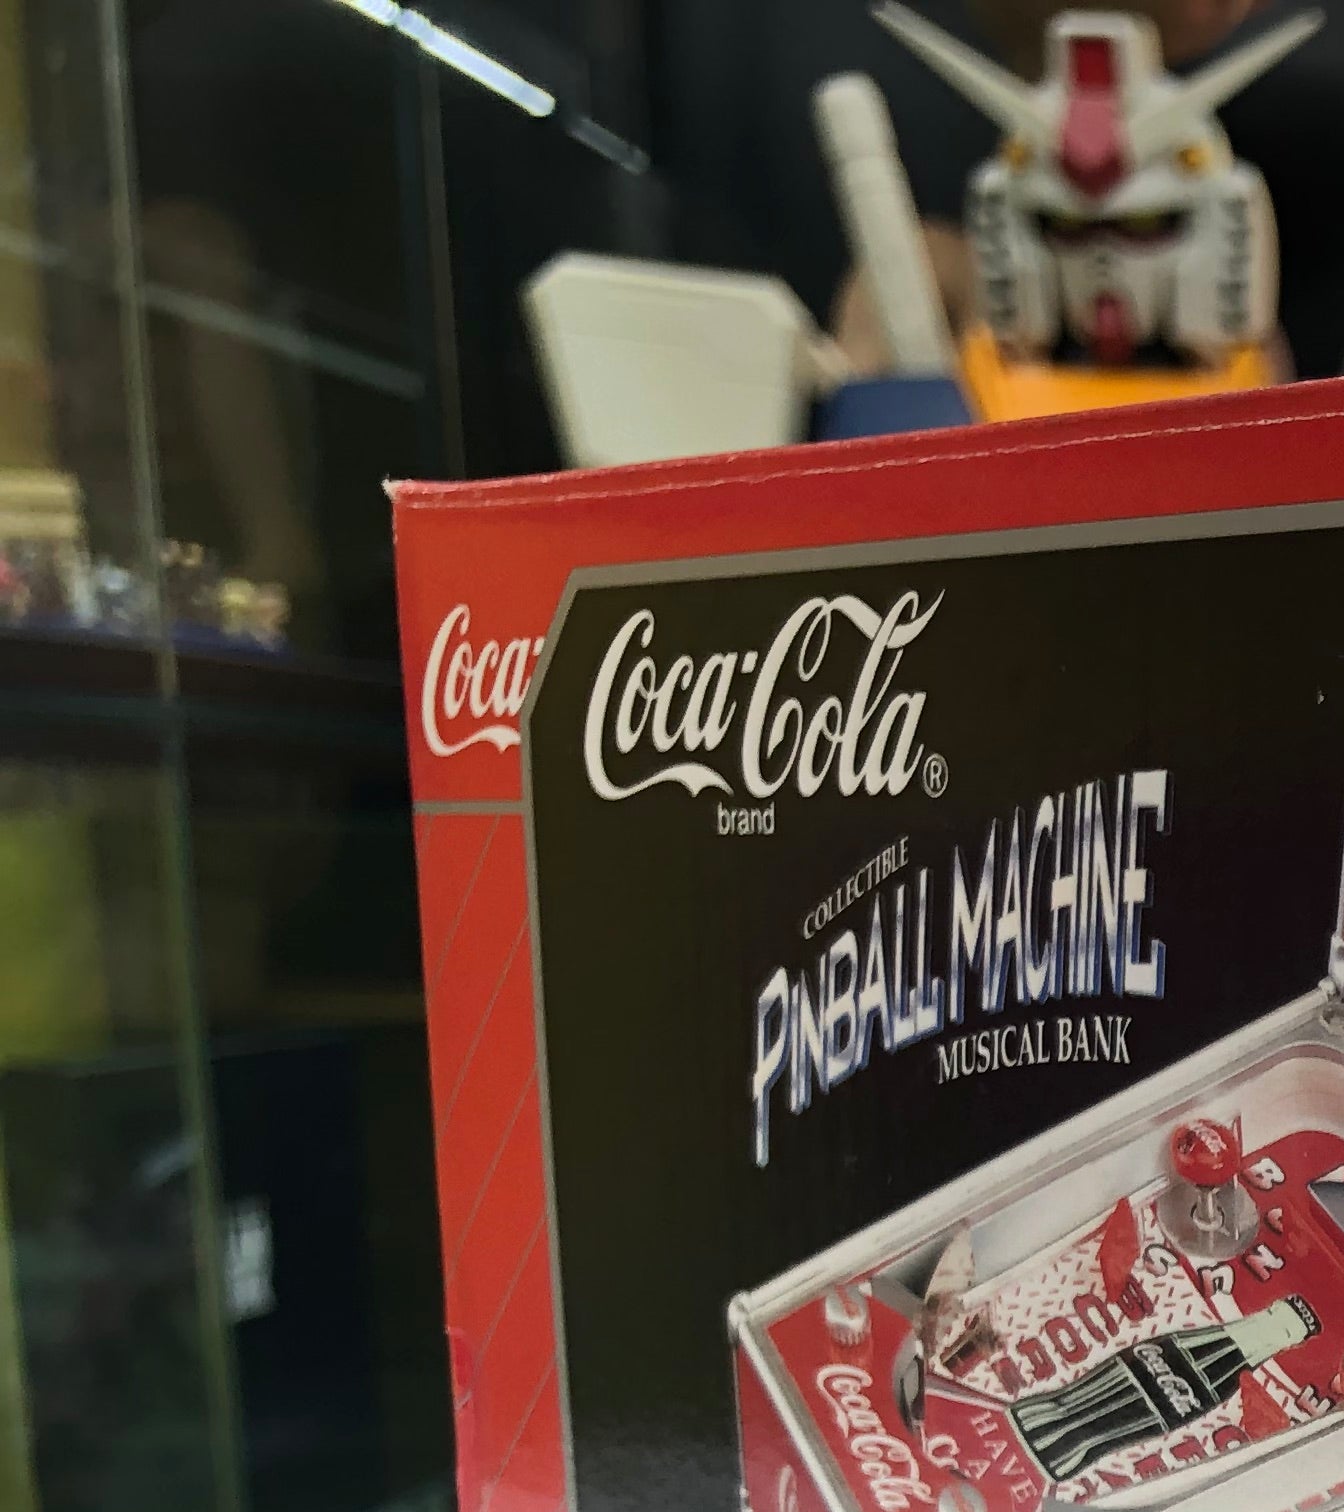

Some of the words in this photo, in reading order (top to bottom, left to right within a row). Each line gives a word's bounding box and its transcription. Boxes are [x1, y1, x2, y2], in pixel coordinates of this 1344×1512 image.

[717, 803, 775, 836] brand
[802, 837, 910, 940] COLLECTIBLE
[751, 869, 945, 1168] PINBALL
[944, 770, 1172, 1025] MACHINE
[937, 1023, 1051, 1085] MUSICAL
[1056, 1017, 1133, 1068] BANK
[963, 1459, 991, 1481] A
[970, 1411, 1040, 1500] HAVE
